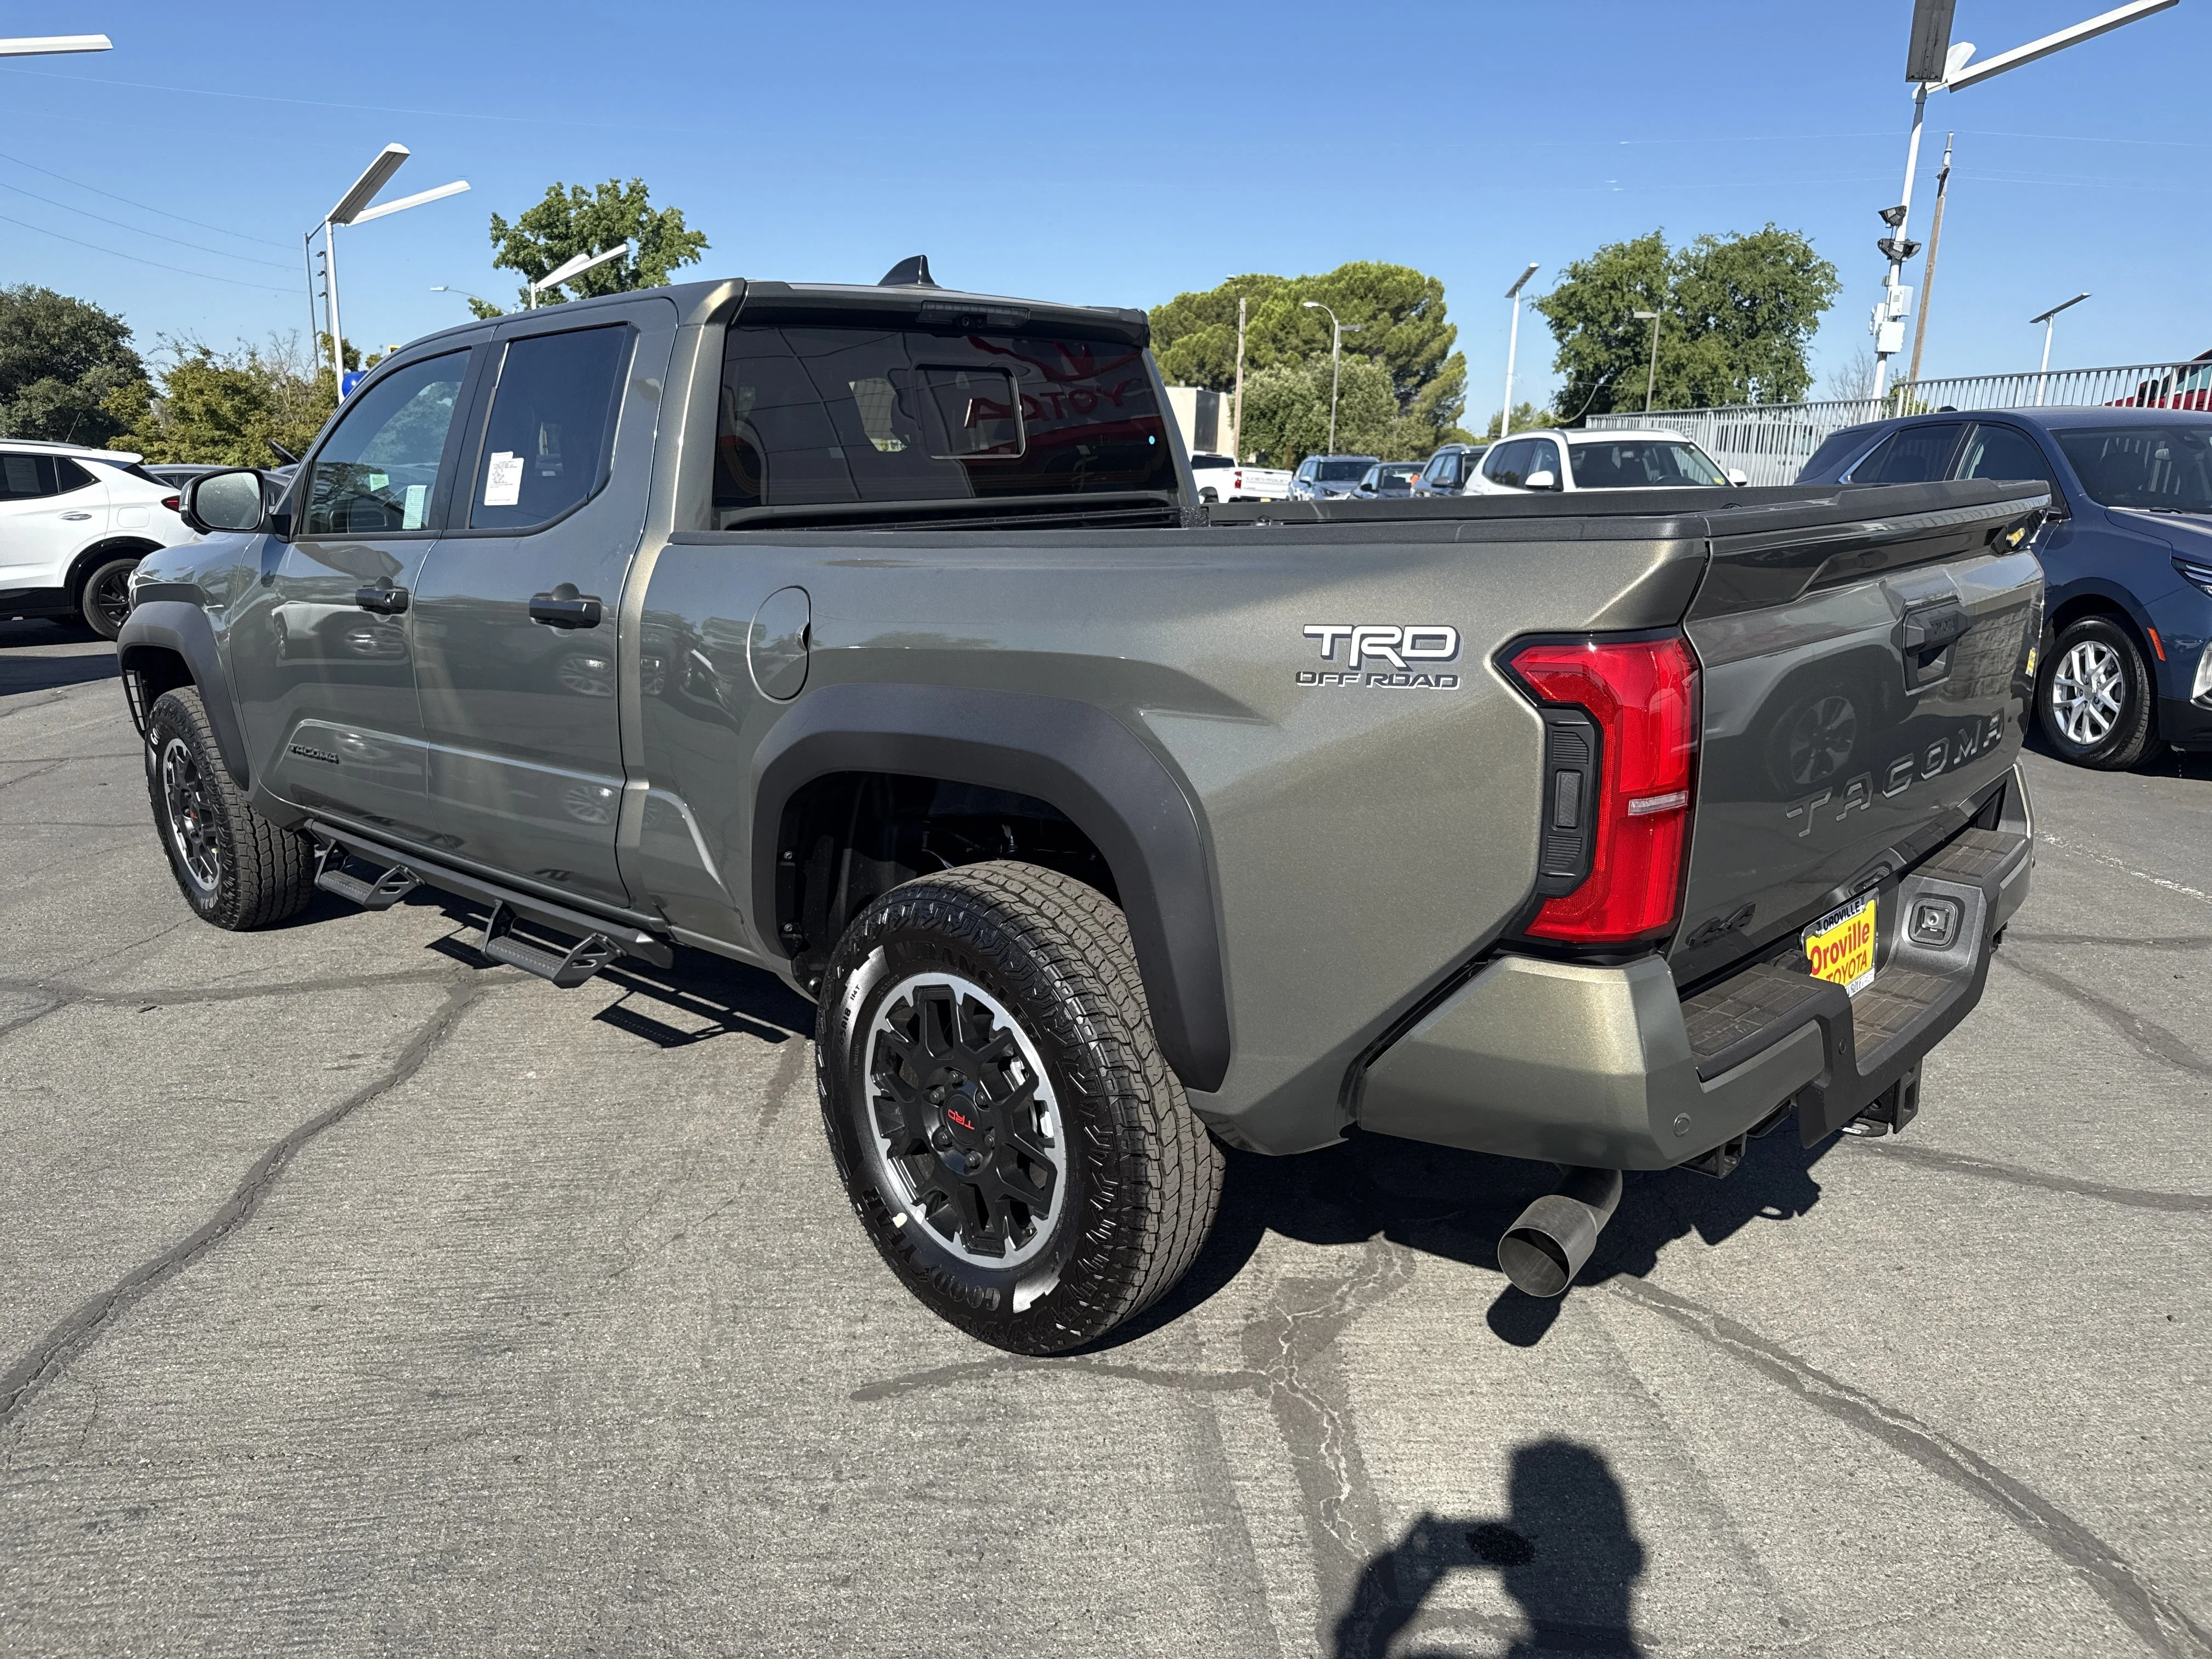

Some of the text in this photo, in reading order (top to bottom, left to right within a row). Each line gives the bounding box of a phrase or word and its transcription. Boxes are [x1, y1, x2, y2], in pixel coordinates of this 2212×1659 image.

[1302, 624, 1462, 672] TRD
[1295, 672, 1461, 690] OFF ROAD
[290, 743, 340, 765] TACOMA
[1785, 707, 2005, 838] TACOMA
[1822, 901, 1860, 931] OROVILLE
[1810, 920, 1870, 976] Oroville
[947, 1109, 975, 1130] TRD
